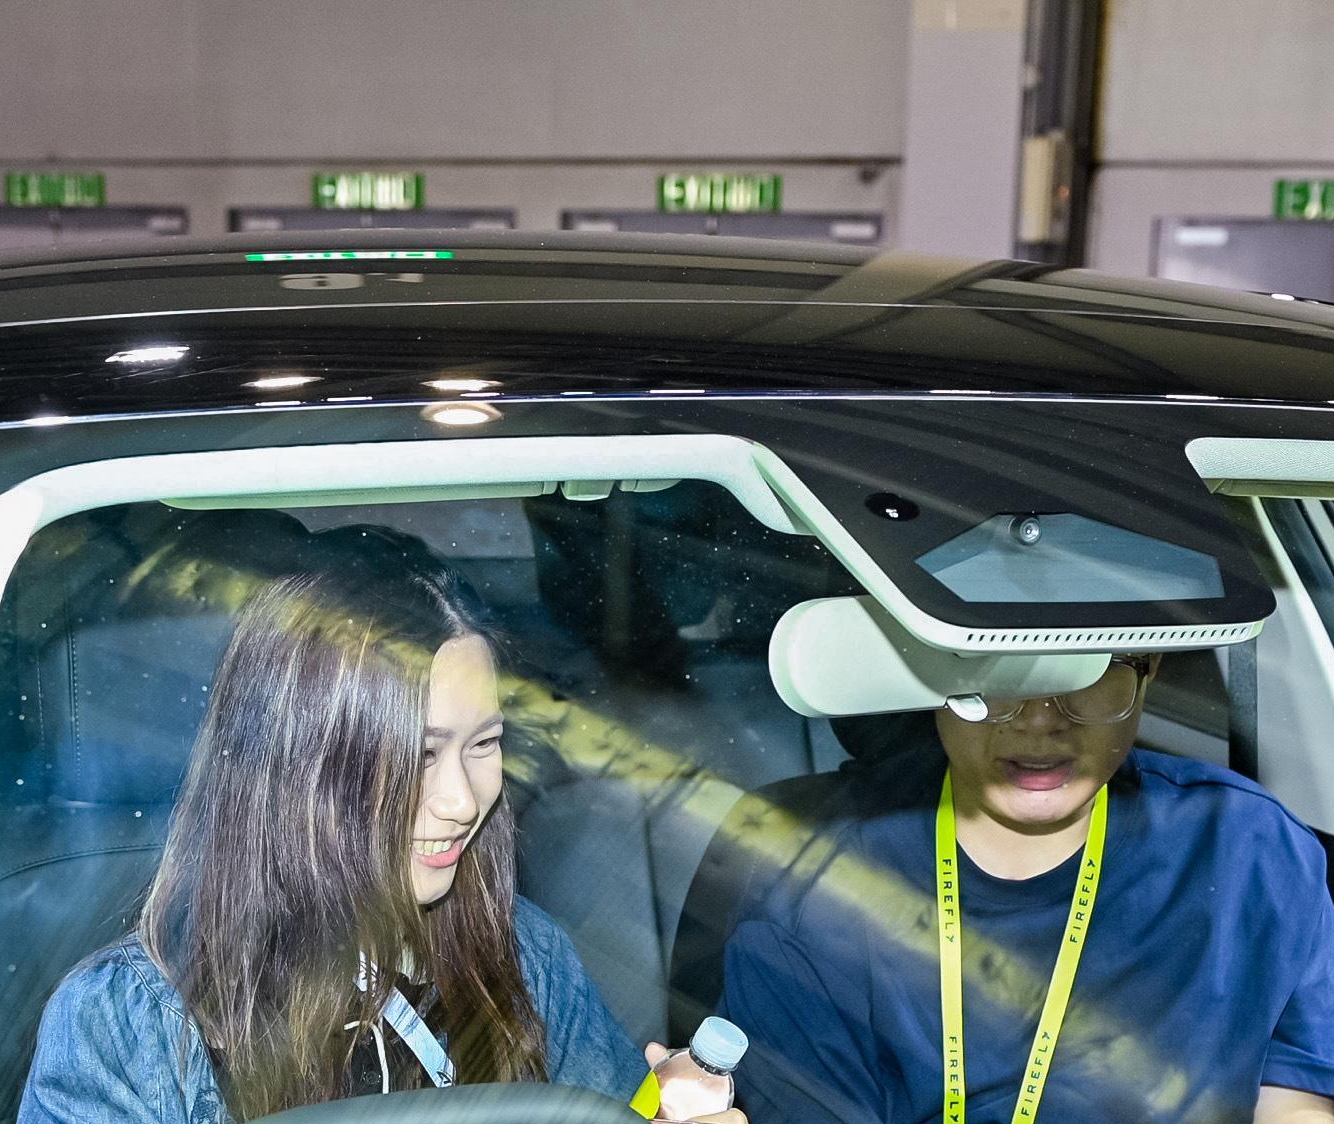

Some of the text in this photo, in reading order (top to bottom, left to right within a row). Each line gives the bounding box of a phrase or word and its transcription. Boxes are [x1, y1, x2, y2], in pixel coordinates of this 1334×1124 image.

[942, 858, 955, 943] FIREFLY
[1069, 858, 1096, 943] FIREFLY
[949, 1036, 960, 1123] FIREFLY
[1021, 1031, 1051, 1117] FIREFLY
